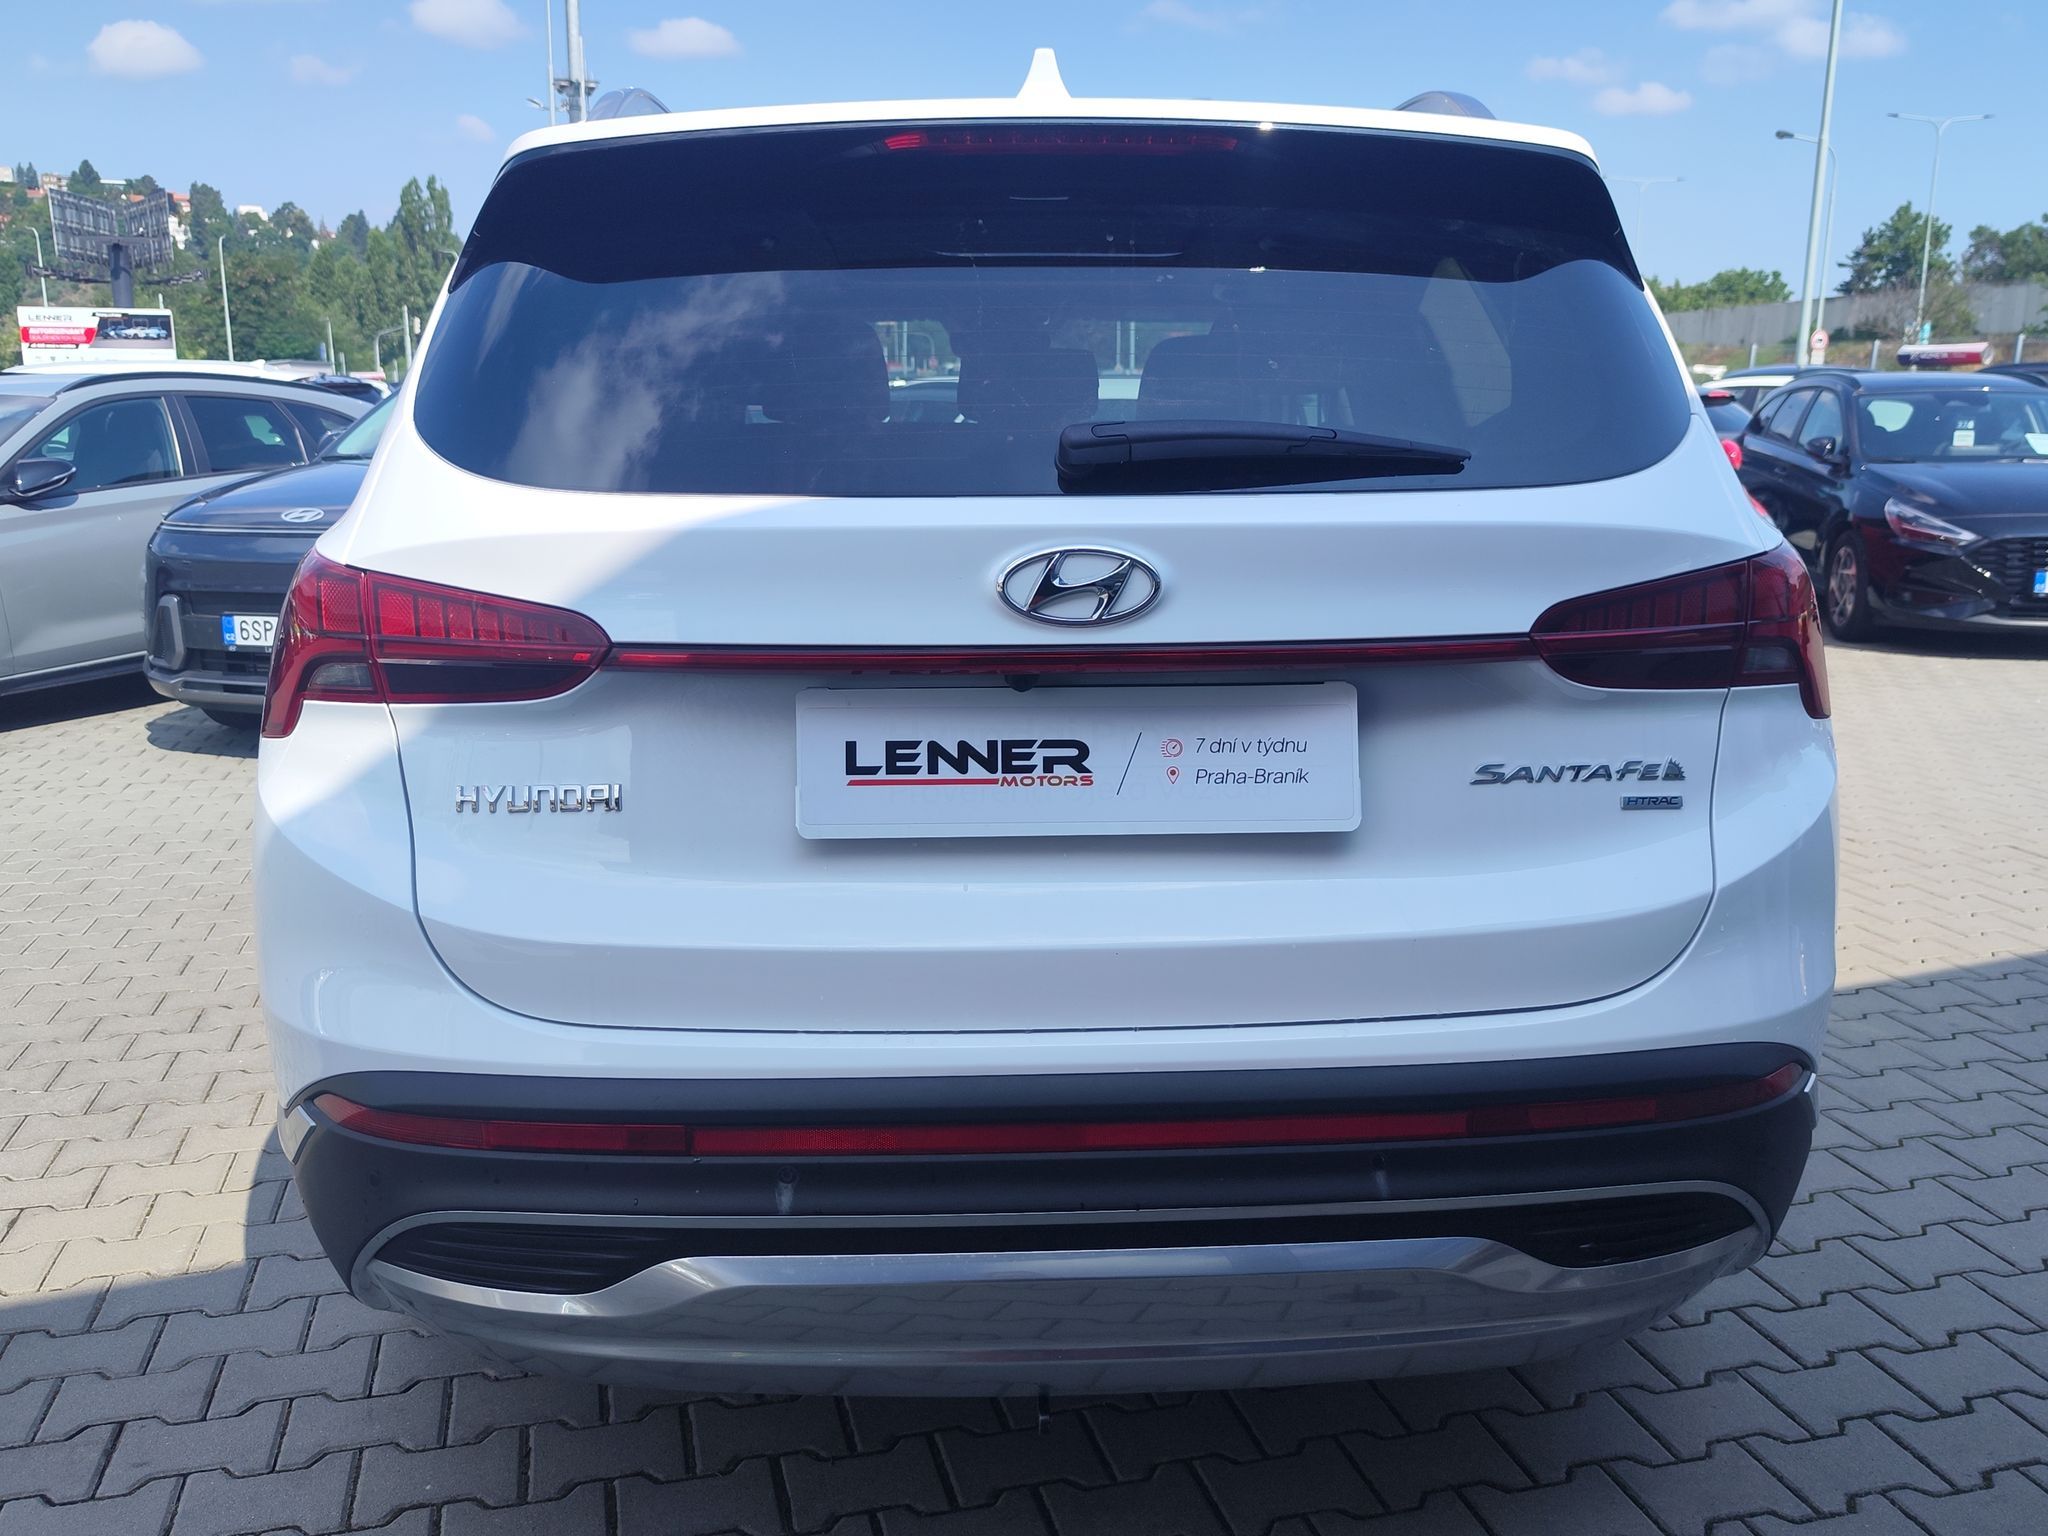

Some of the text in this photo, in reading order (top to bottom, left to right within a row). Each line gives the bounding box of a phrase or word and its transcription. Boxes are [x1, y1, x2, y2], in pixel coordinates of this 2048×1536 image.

[240, 620, 273, 641] 6SP
[1195, 736, 1309, 757] 7 dní v týdnu
[845, 739, 1093, 776] LENNER
[999, 774, 1094, 788] MOTORS
[1194, 767, 1310, 786] Praha-Braník
[455, 783, 622, 813] HYUNDAI
[1625, 796, 1680, 806] HTRAC
